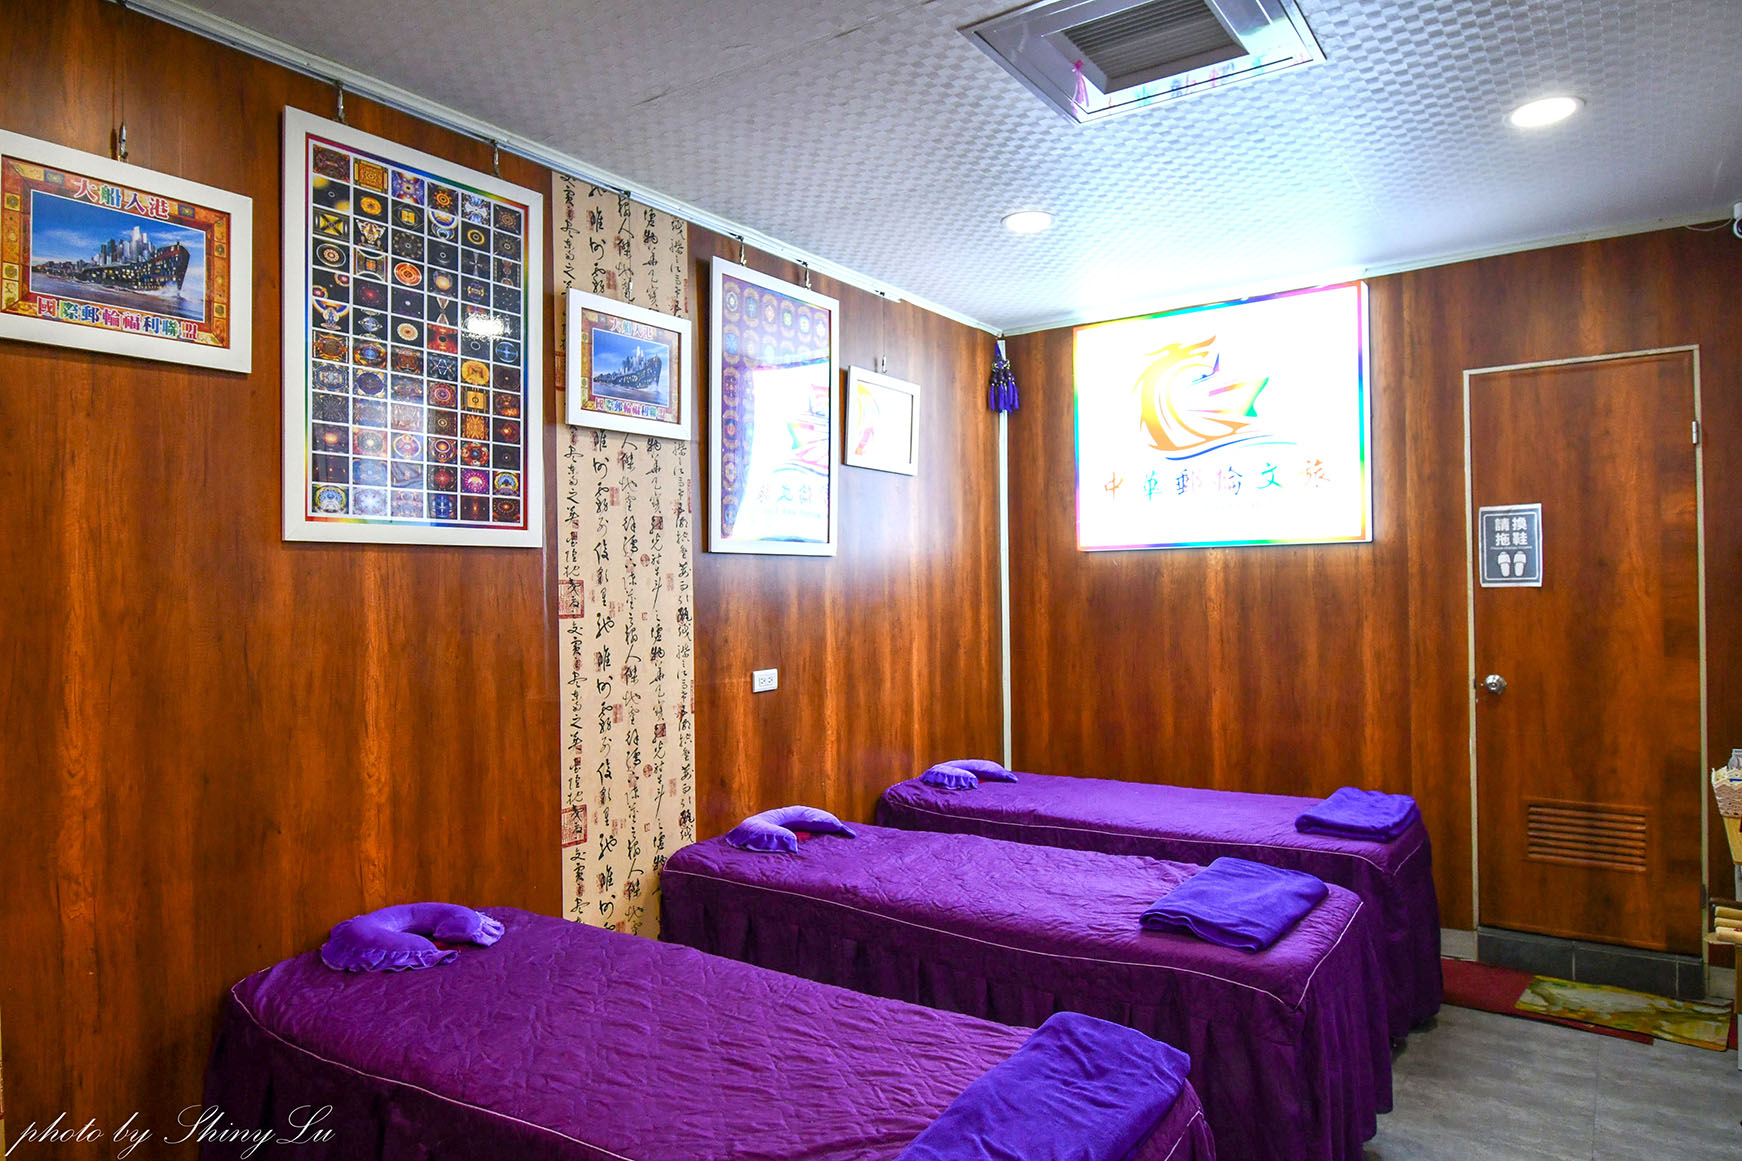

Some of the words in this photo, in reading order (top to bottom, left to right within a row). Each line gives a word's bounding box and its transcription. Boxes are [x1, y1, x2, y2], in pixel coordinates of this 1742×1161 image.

[37, 296, 199, 340] 國際郵輪福利聯盟
[1495, 516, 1527, 531] 請換
[1495, 532, 1528, 546] 拖鞋
